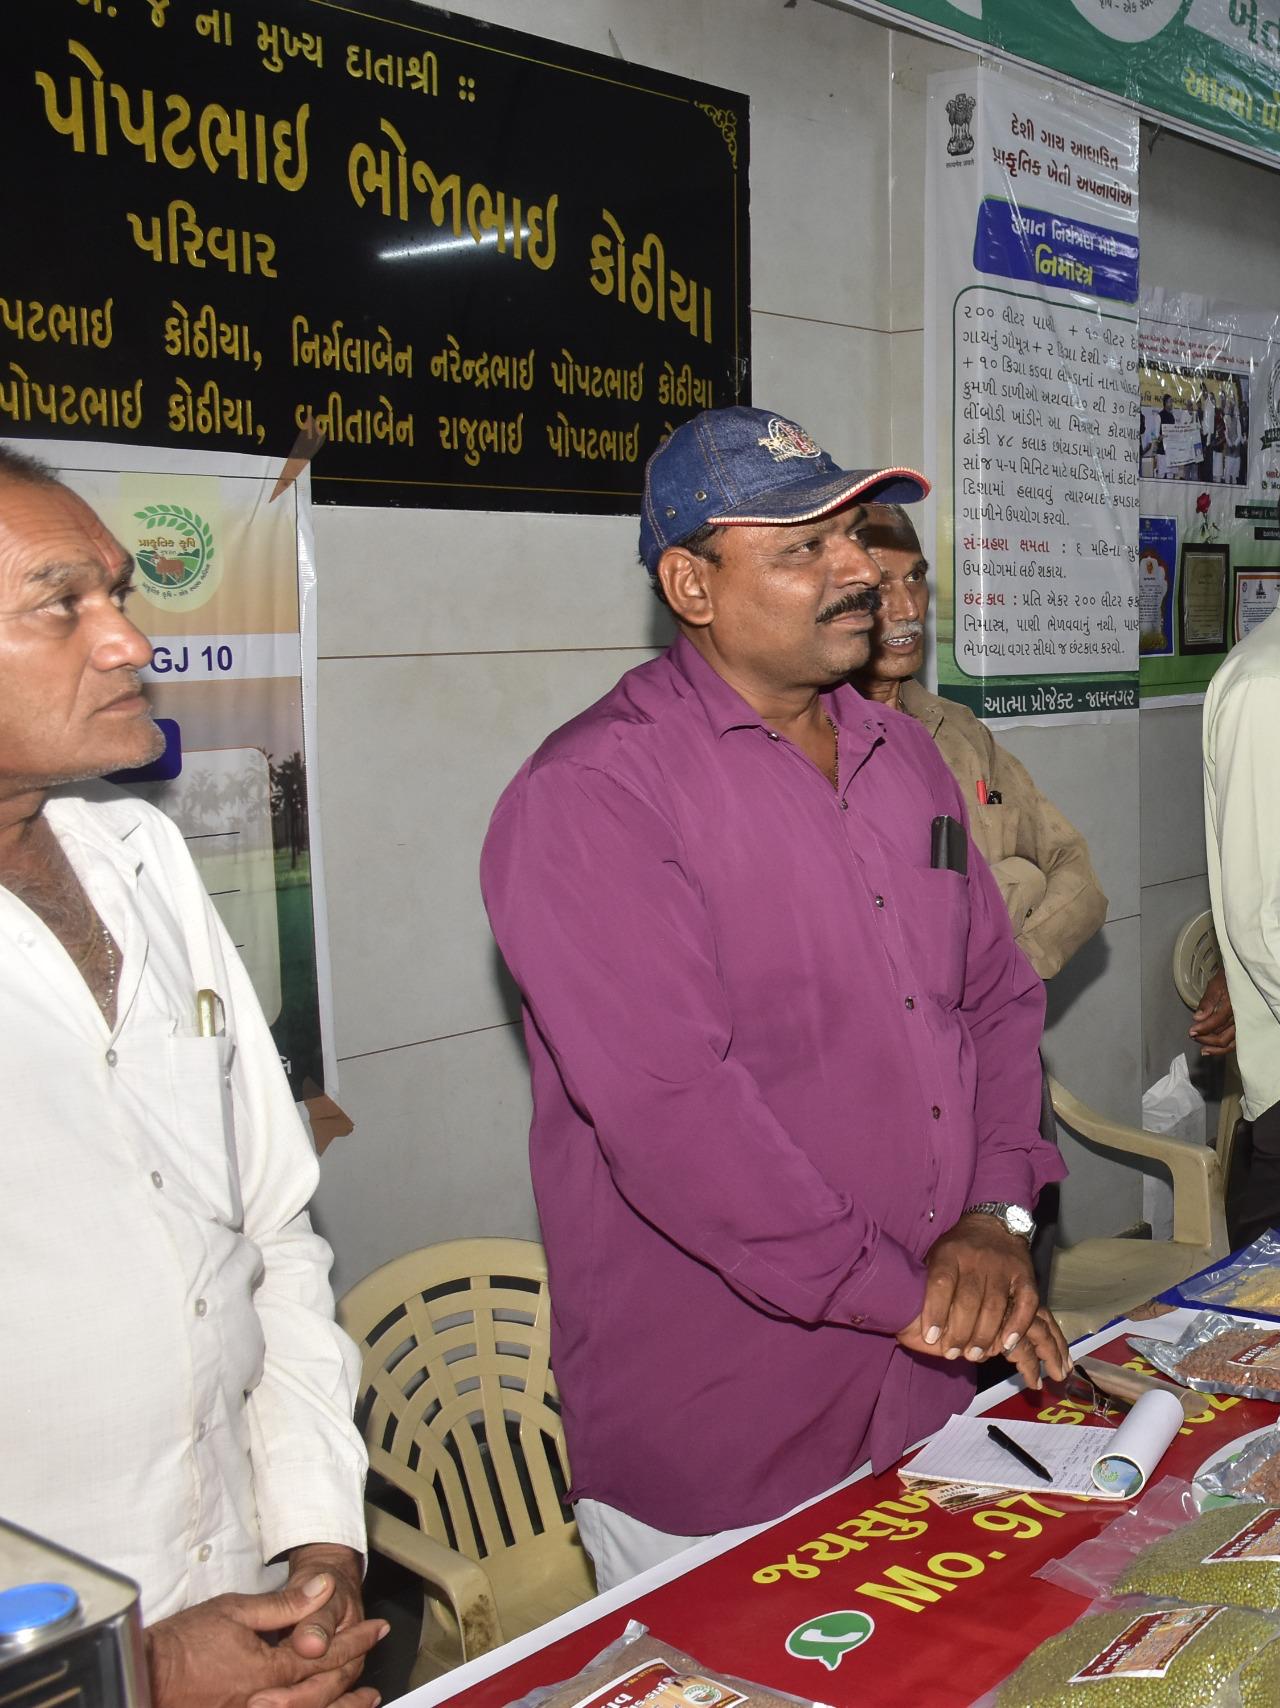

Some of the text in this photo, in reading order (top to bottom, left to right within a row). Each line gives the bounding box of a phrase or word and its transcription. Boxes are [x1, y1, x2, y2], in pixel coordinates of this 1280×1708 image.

[195, 9, 232, 46] ના
[257, 21, 323, 73] મુખ્ય
[346, 45, 438, 96] દાતાશ્રી
[1011, 113, 1119, 171] દેશી ગાય આધારિત
[993, 147, 1042, 177] પ્રાકૃતિક
[1047, 160, 1071, 186] ખેતી
[126, 199, 278, 278] પરિવાર
[590, 208, 713, 344] કોઠીયા
[964, 306, 994, 318] ૨૦૦
[1003, 306, 1025, 326] લીટર
[292, 315, 413, 378] નિર્મલાબેન
[962, 330, 999, 351] ગાયનું
[1080, 346, 1100, 365] દેશી
[979, 356, 998, 370] ૧૦
[997, 434, 1014, 447] ૪૮
[1021, 437, 1047, 451] કલાક
[963, 453, 992, 470] સાંજ
[1020, 456, 1050, 476] મિનિટ
[963, 477, 1005, 497] દિશામાં
[1017, 485, 1054, 506] હલાવવું
[963, 503, 1004, 521] ગાળીને
[1006, 505, 1041, 524] ઉપયોગ
[1020, 539, 1051, 553] ક્ષમતા
[1091, 540, 1121, 557] મહિના
[963, 559, 1017, 576] ઉપયોગમાં
[1022, 589, 1042, 607] પ્રતિ
[1074, 594, 1096, 607] ૨૦૦
[1017, 614, 1041, 632] પાણી
[150, 645, 233, 673] GJ 10
[1007, 643, 1031, 656] વગર
[984, 694, 1028, 714] આત્મા
[1085, 689, 1135, 708] જામનગર
